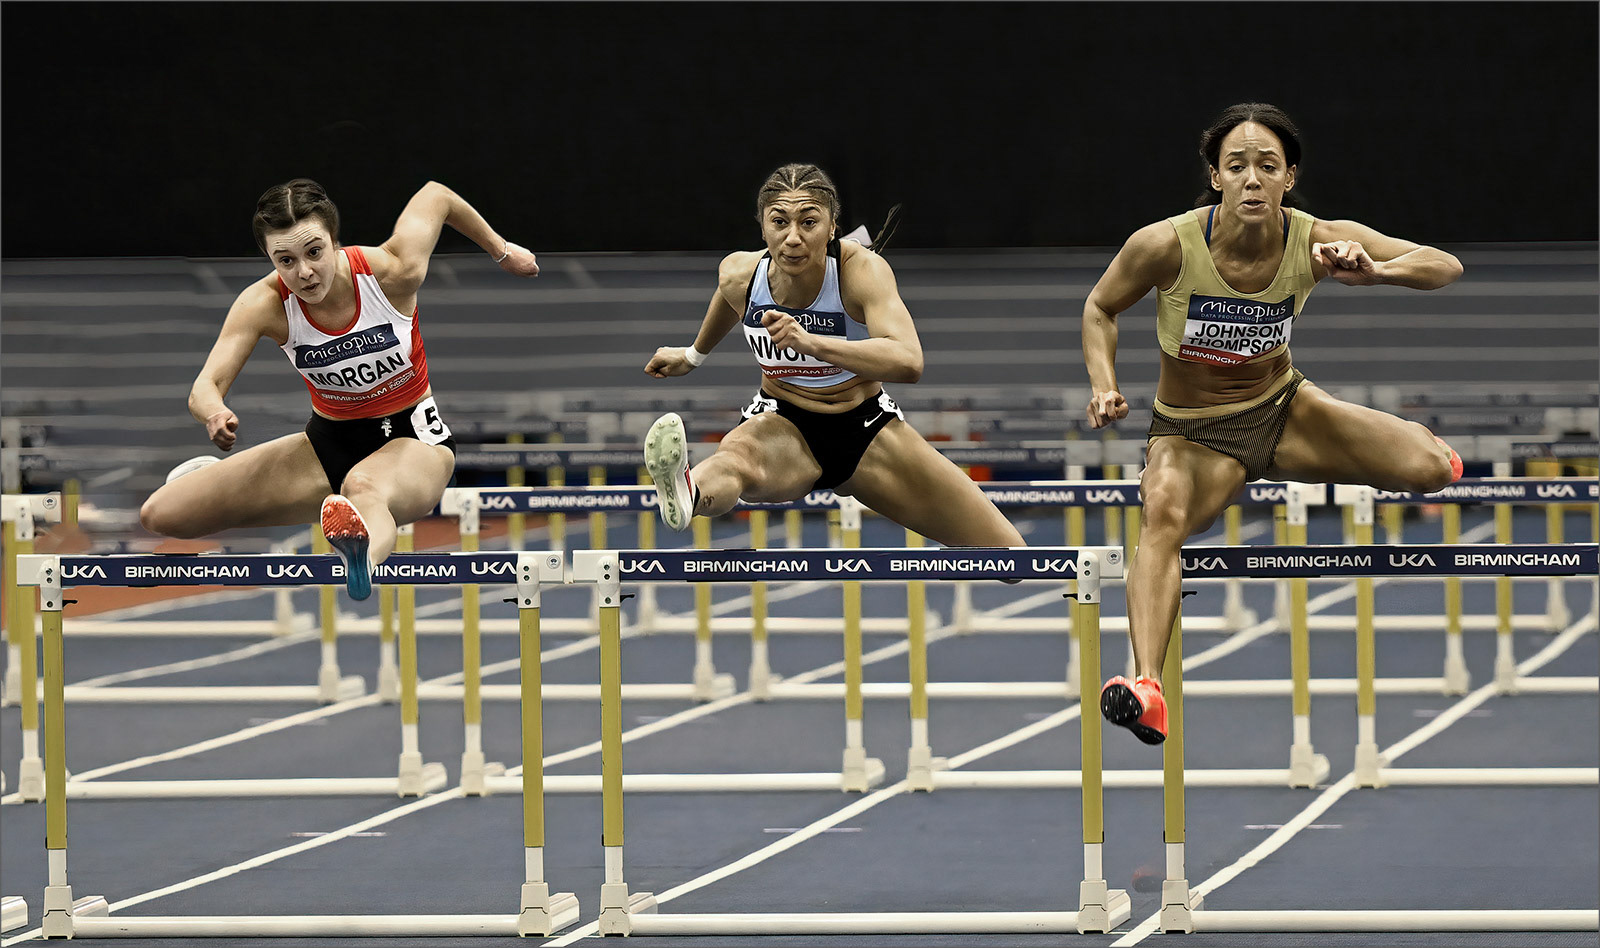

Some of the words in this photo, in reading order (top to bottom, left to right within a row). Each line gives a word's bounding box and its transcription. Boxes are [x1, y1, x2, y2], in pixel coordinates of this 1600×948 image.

[1217, 314, 1256, 322] PROCESSING
[1195, 322, 1284, 339] JOHNSON
[308, 352, 405, 388] MORGAN
[424, 406, 443, 435] 5
[1086, 490, 1125, 503] UKA
[1250, 487, 1287, 501] UKA
[1537, 485, 1577, 498] UKA
[480, 494, 516, 509] UKA
[528, 495, 629, 508] BIRMINGHAM
[619, 560, 666, 573] UKA
[683, 560, 808, 573] BIRMINGHAM
[825, 559, 873, 572] UKA
[890, 559, 1015, 572] BIRMINGHAM
[1032, 559, 1078, 572] UKA
[1182, 556, 1228, 570] UKA
[1246, 555, 1372, 568] BIRMINGHAM
[1389, 553, 1436, 567] UKA
[1454, 553, 1580, 566] BIRMINGHAM
[60, 565, 107, 579] UKA
[125, 565, 250, 578] BIRMINGHAM
[266, 564, 314, 578] UKA
[331, 565, 457, 578] BIMINGHAM
[471, 561, 517, 575] UKA
